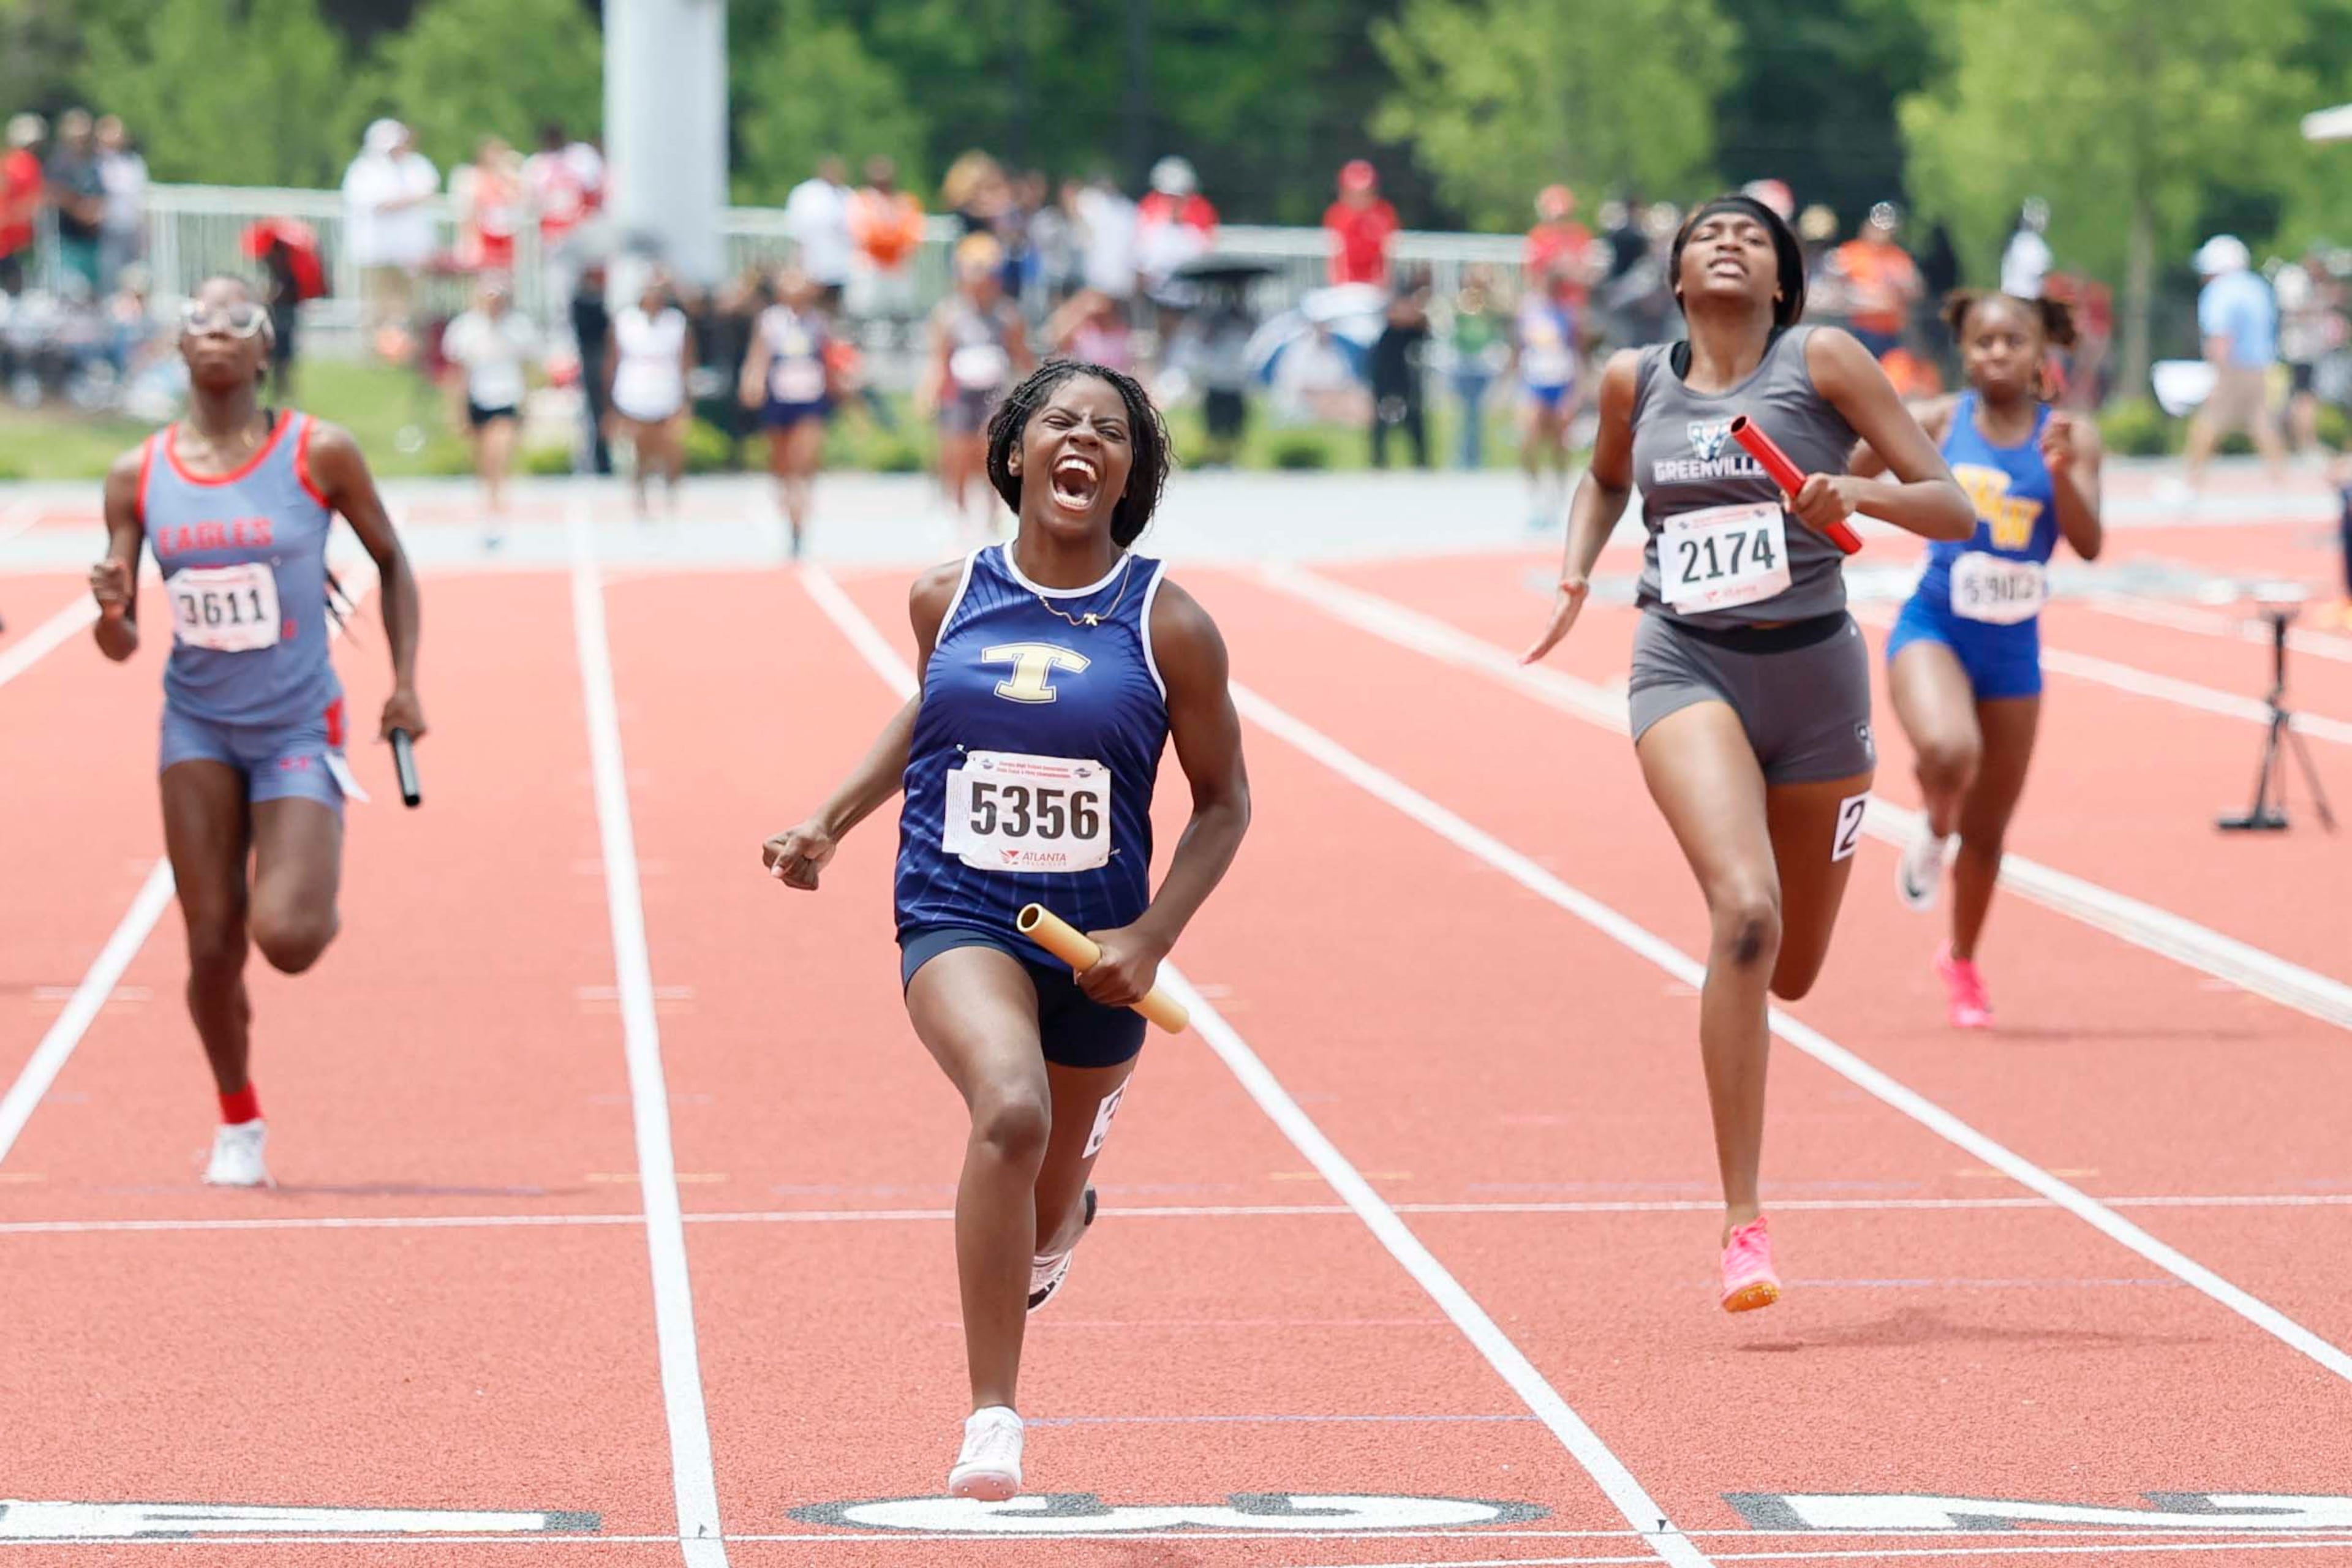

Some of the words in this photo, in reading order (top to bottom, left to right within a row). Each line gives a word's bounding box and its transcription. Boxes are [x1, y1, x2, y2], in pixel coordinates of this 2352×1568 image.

[157, 516, 273, 557] EAGLES
[1679, 529, 1775, 584] 2174
[179, 589, 265, 628] 3611
[982, 642, 1091, 704] T
[971, 781, 1099, 840] 5356
[1839, 800, 1865, 851] 2
[1022, 851, 1066, 862] ATLANTA
